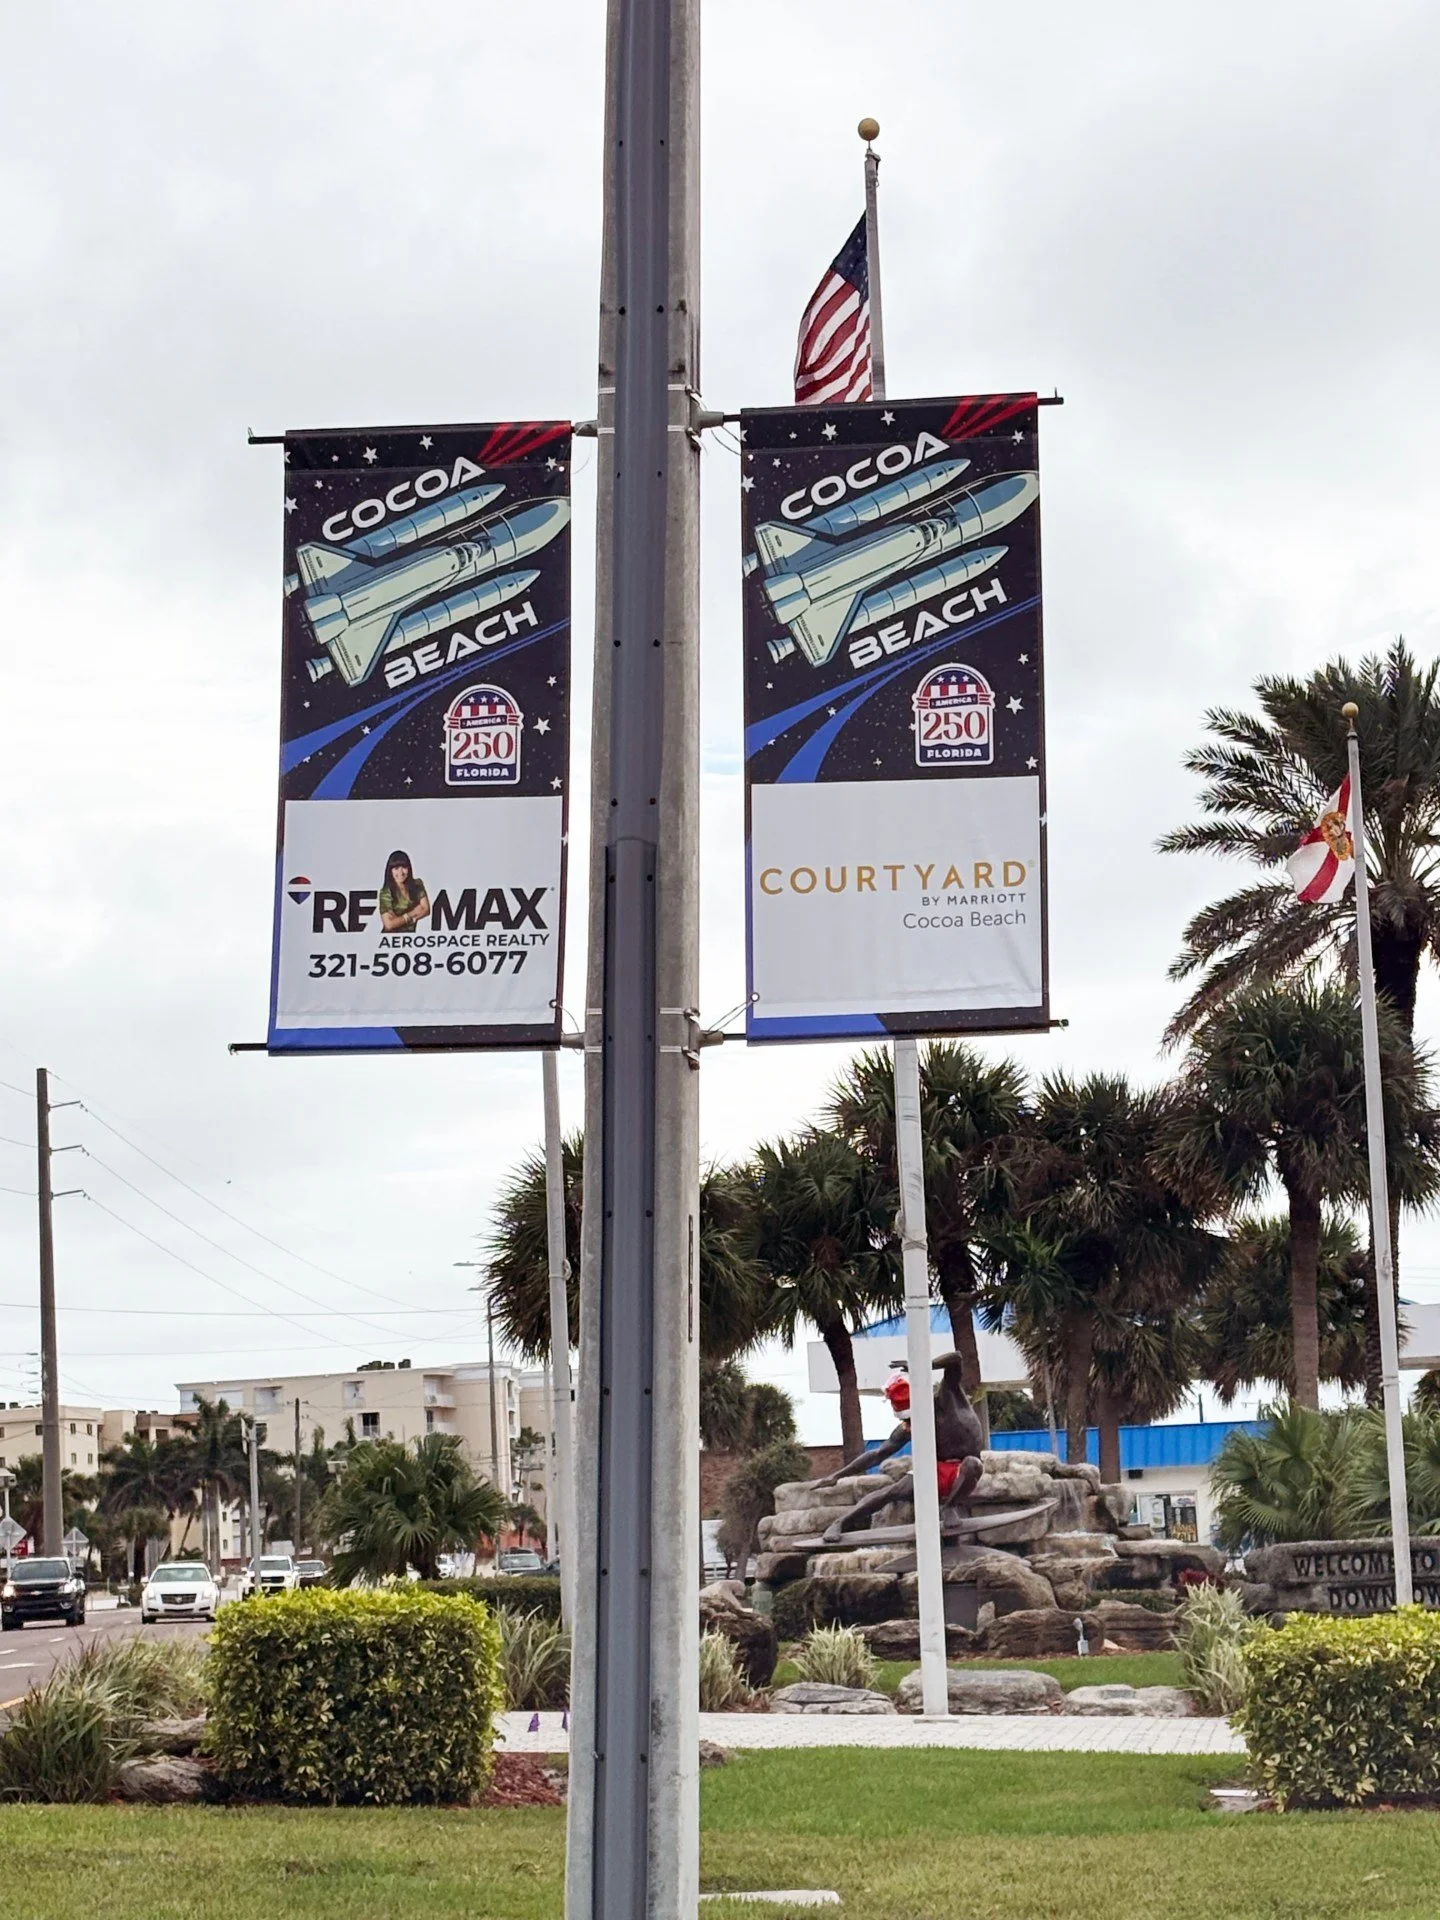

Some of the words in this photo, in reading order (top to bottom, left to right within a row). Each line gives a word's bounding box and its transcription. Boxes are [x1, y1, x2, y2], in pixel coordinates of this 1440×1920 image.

[780, 431, 951, 521] COCOA
[321, 456, 487, 542] COCOA
[848, 577, 1008, 670] BEACH
[383, 601, 540, 690] BEACH
[935, 696, 973, 707] AMERICA
[465, 716, 502, 727] AMERICA
[922, 710, 986, 741] 250
[452, 730, 514, 760] 250
[926, 748, 983, 759] FLORIDA
[455, 767, 510, 778] FLORIDA
[759, 860, 1027, 895] COURTYARD
[921, 896, 940, 907] BY
[946, 892, 1027, 906] MARRIOTT
[902, 912, 964, 930] Cocoa
[970, 909, 1027, 927] Beach
[378, 934, 481, 949] AEROSPACE
[486, 933, 550, 947] REALTY
[308, 950, 529, 979] 321-508-6077
[1292, 1551, 1395, 1577] WELCOME
[1328, 1583, 1440, 1609] DOWNOW
